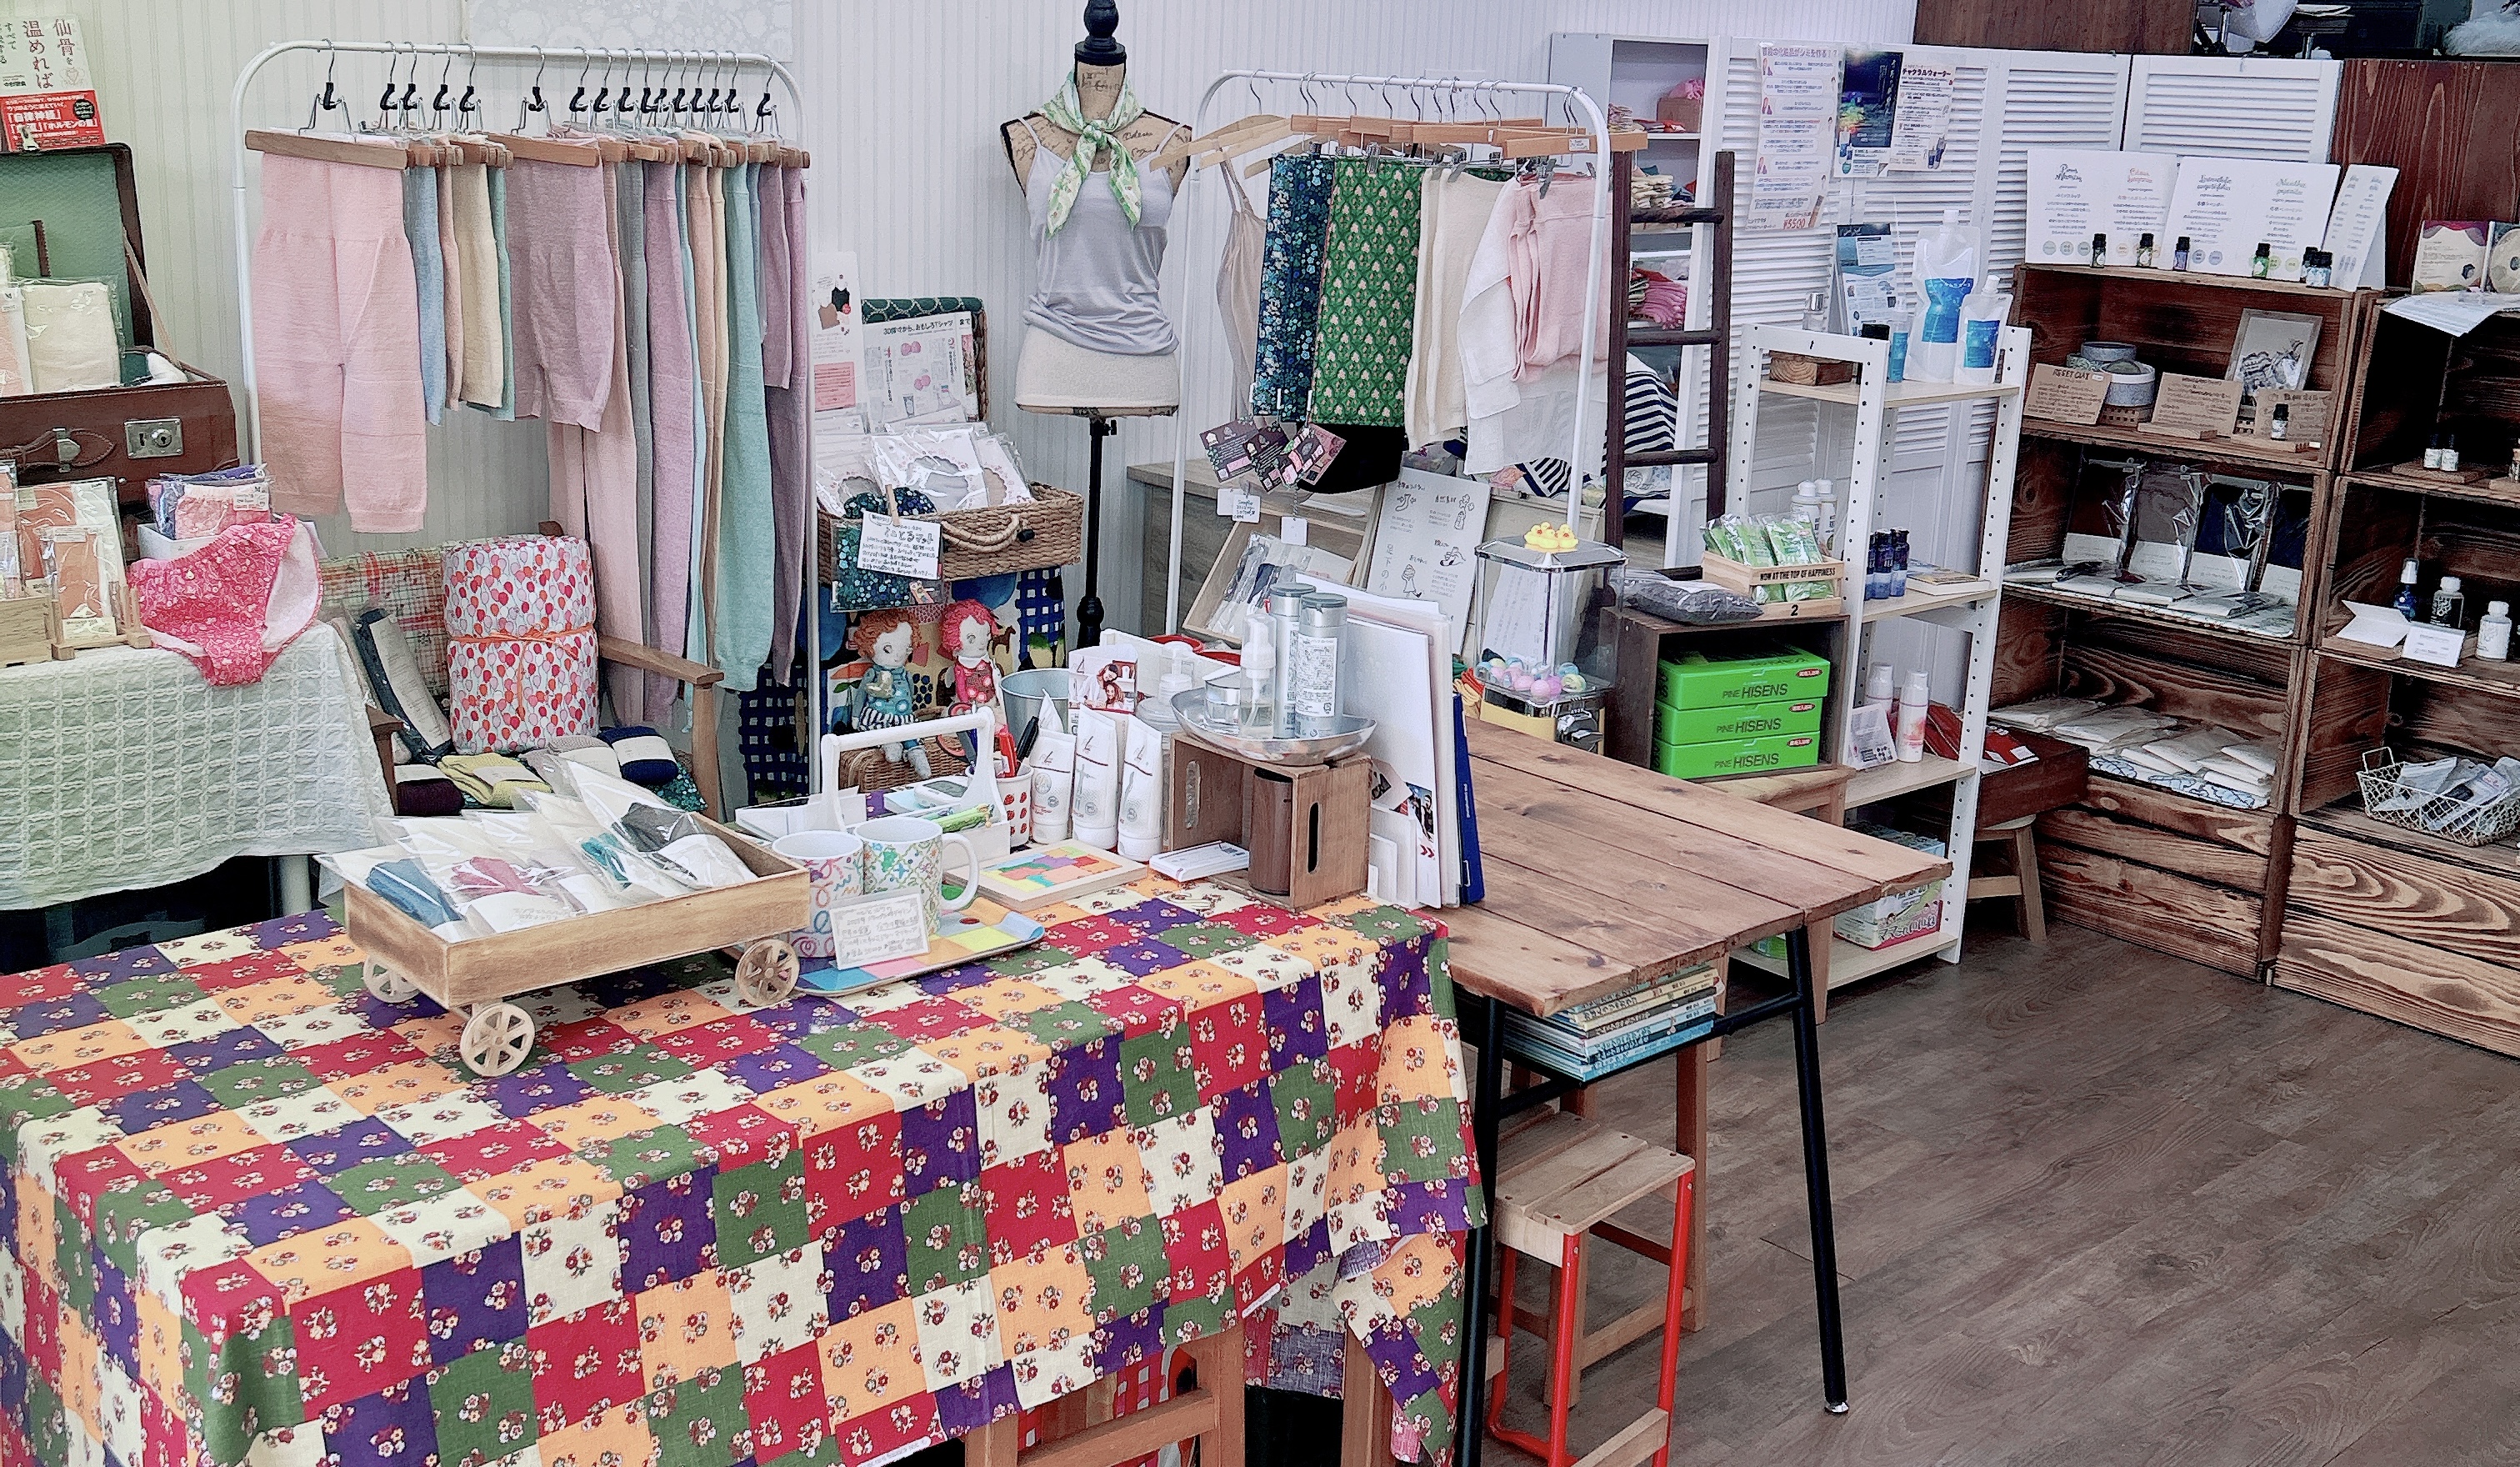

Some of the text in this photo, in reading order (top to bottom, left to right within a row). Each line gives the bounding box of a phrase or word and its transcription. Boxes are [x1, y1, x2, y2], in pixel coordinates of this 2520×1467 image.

[54, 18, 75, 65] 仙骨を
[22, 20, 54, 89] 温めれば
[1791, 604, 1798, 616] 2
[1722, 683, 1788, 699] PINE HISENS
[1716, 718, 1782, 734] PINE HISENS
[1733, 754, 1779, 769] HISENS
